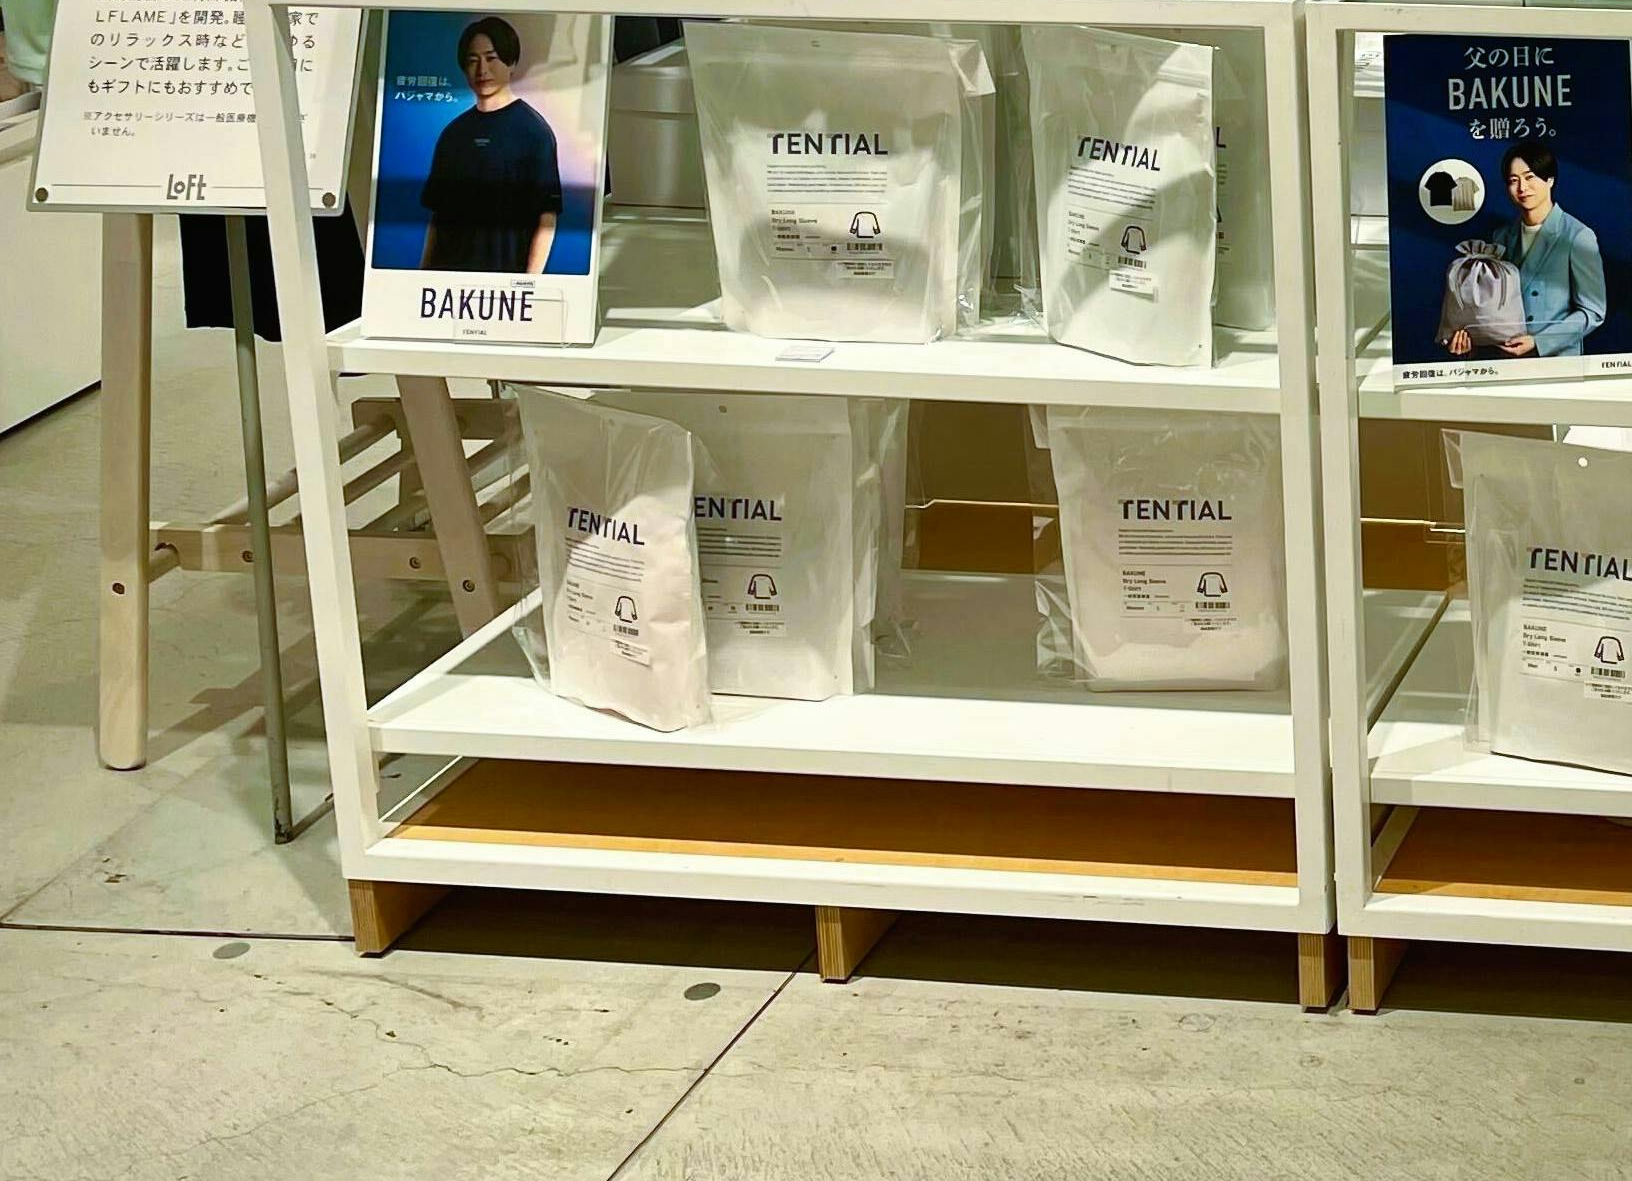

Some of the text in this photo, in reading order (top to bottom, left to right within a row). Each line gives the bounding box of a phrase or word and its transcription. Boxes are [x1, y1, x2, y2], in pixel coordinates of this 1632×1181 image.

[1464, 46, 1554, 70] 父の日に
[1447, 73, 1573, 111] BAKUNE
[1469, 118, 1558, 140] を贈ろう。
[766, 132, 888, 156] TENTIAL
[1076, 136, 1161, 172] TENTIAL
[420, 287, 534, 322] BAKUNE
[694, 496, 783, 522] ENTIAL
[1119, 499, 1233, 521] TENTIAL
[567, 507, 645, 546] TENTIAL
